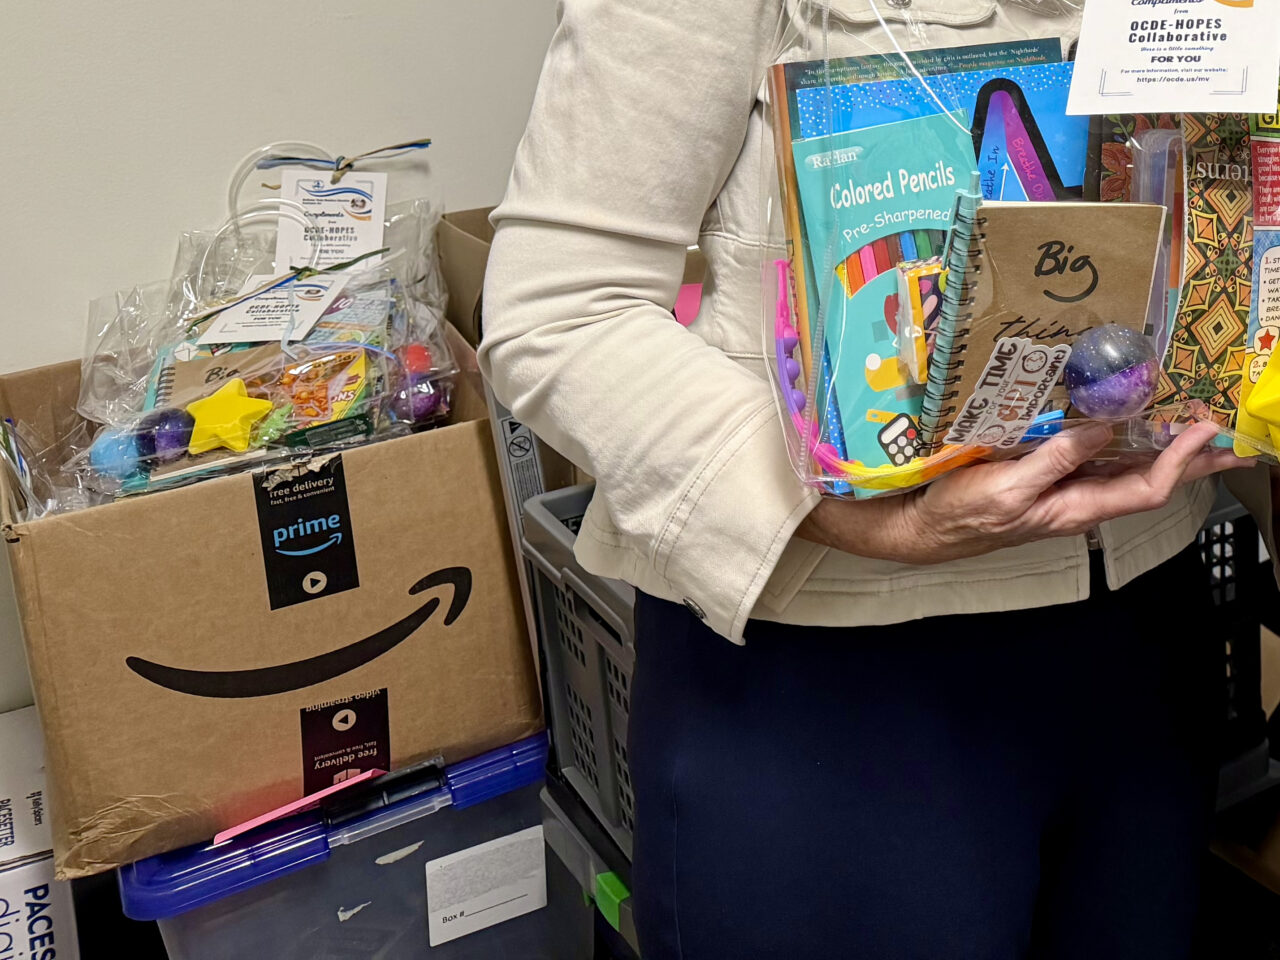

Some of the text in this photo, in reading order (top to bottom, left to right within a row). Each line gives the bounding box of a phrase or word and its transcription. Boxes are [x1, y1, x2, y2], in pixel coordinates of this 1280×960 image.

[1130, 17, 1222, 31] OCDE-HOPES
[1128, 29, 1227, 42] Collaborative
[1150, 54, 1201, 63] FOR YOU
[1136, 74, 1210, 83] https://ocde.us/mv
[1012, 136, 1035, 182] Breathe
[1196, 161, 1250, 184] terns
[830, 160, 955, 210] Colored Pencils
[984, 168, 997, 201] eathe
[842, 208, 951, 242] Pre-Sharpened
[1034, 240, 1099, 303] Big
[993, 315, 1094, 341] thin
[946, 337, 1019, 449] MAKE TIME
[293, 476, 335, 494] delivery
[284, 495, 297, 503] free
[273, 514, 341, 547] prime
[354, 688, 380, 701] video
[312, 747, 377, 769] free delivery
[442, 914, 457, 924] Box
